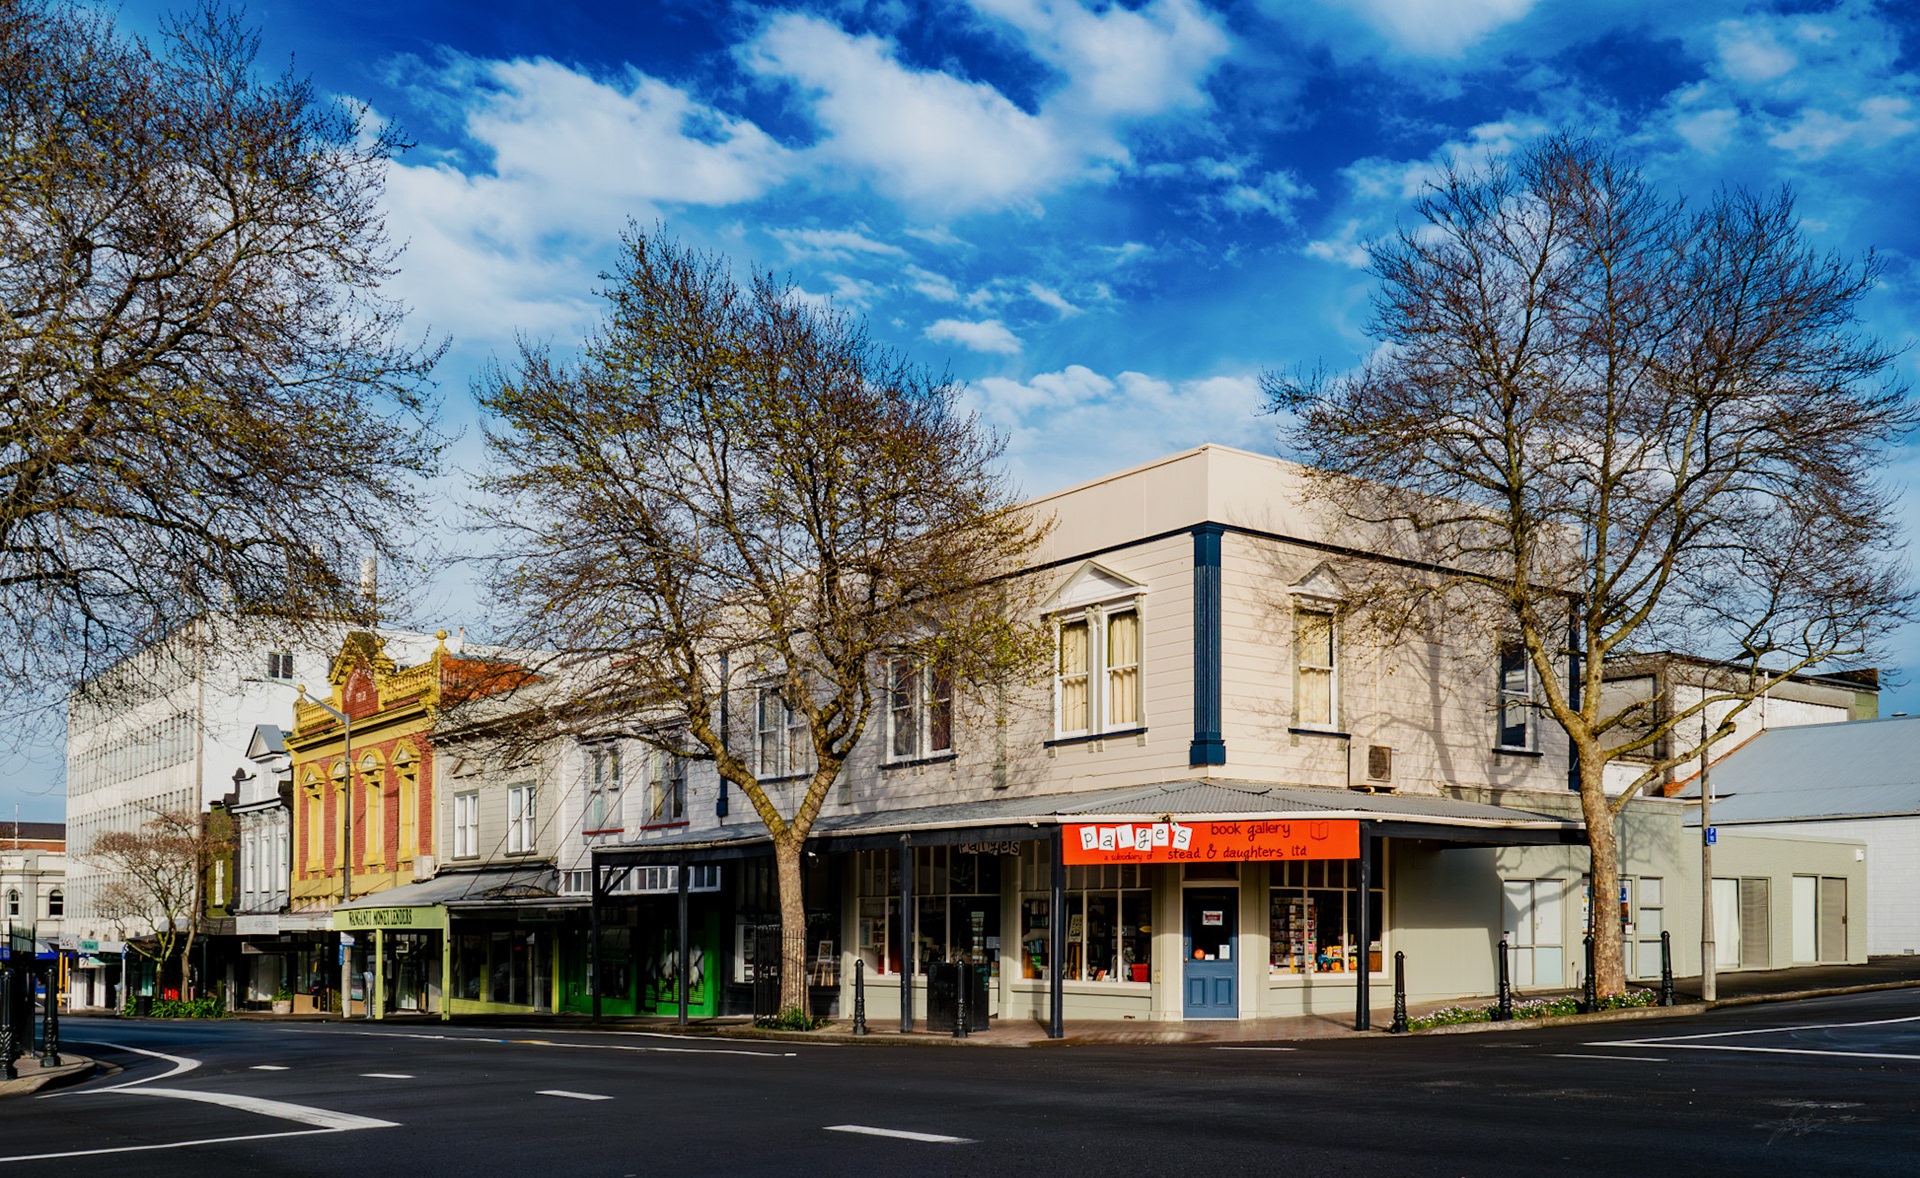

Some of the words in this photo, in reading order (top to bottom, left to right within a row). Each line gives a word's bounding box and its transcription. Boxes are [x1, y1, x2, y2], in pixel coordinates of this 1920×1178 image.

[1083, 823, 1188, 849] paige's
[1211, 823, 1241, 835] book
[1247, 823, 1290, 841] gallery
[1168, 847, 1201, 859] stead
[1206, 843, 1217, 859] &
[1223, 845, 1283, 861] daughters
[1292, 845, 1307, 856] ltd
